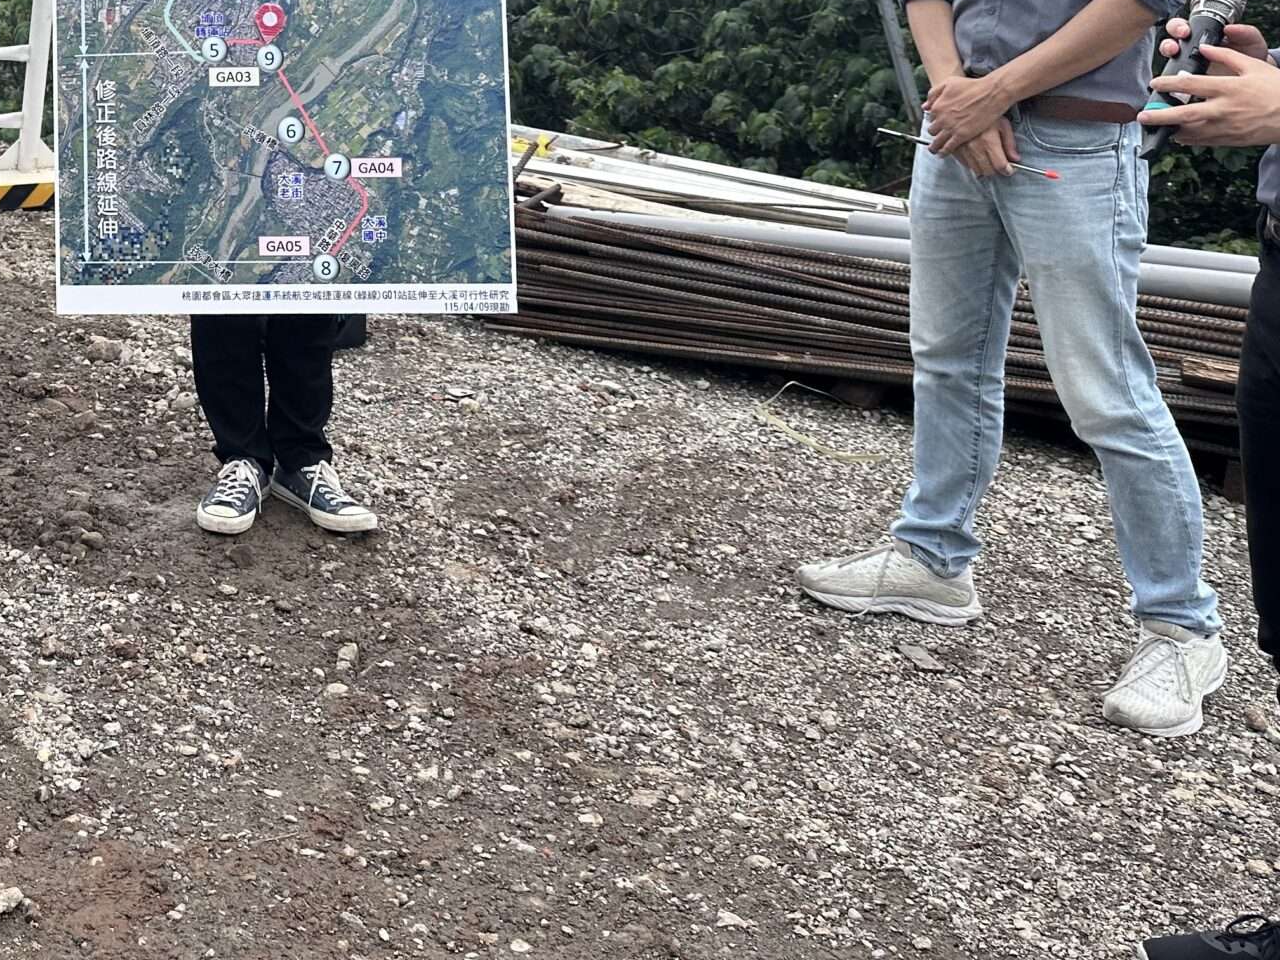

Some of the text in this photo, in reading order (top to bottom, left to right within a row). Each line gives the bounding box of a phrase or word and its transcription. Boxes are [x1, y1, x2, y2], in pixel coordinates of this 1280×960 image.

[210, 44, 219, 58] 5
[264, 51, 274, 66] 9
[216, 72, 251, 83] GA03
[286, 124, 296, 138] 6
[96, 79, 118, 240] 修正後路線延伸
[332, 160, 342, 175] 7
[358, 162, 394, 174] GA04
[266, 241, 302, 252] GA05
[321, 261, 331, 275] 8
